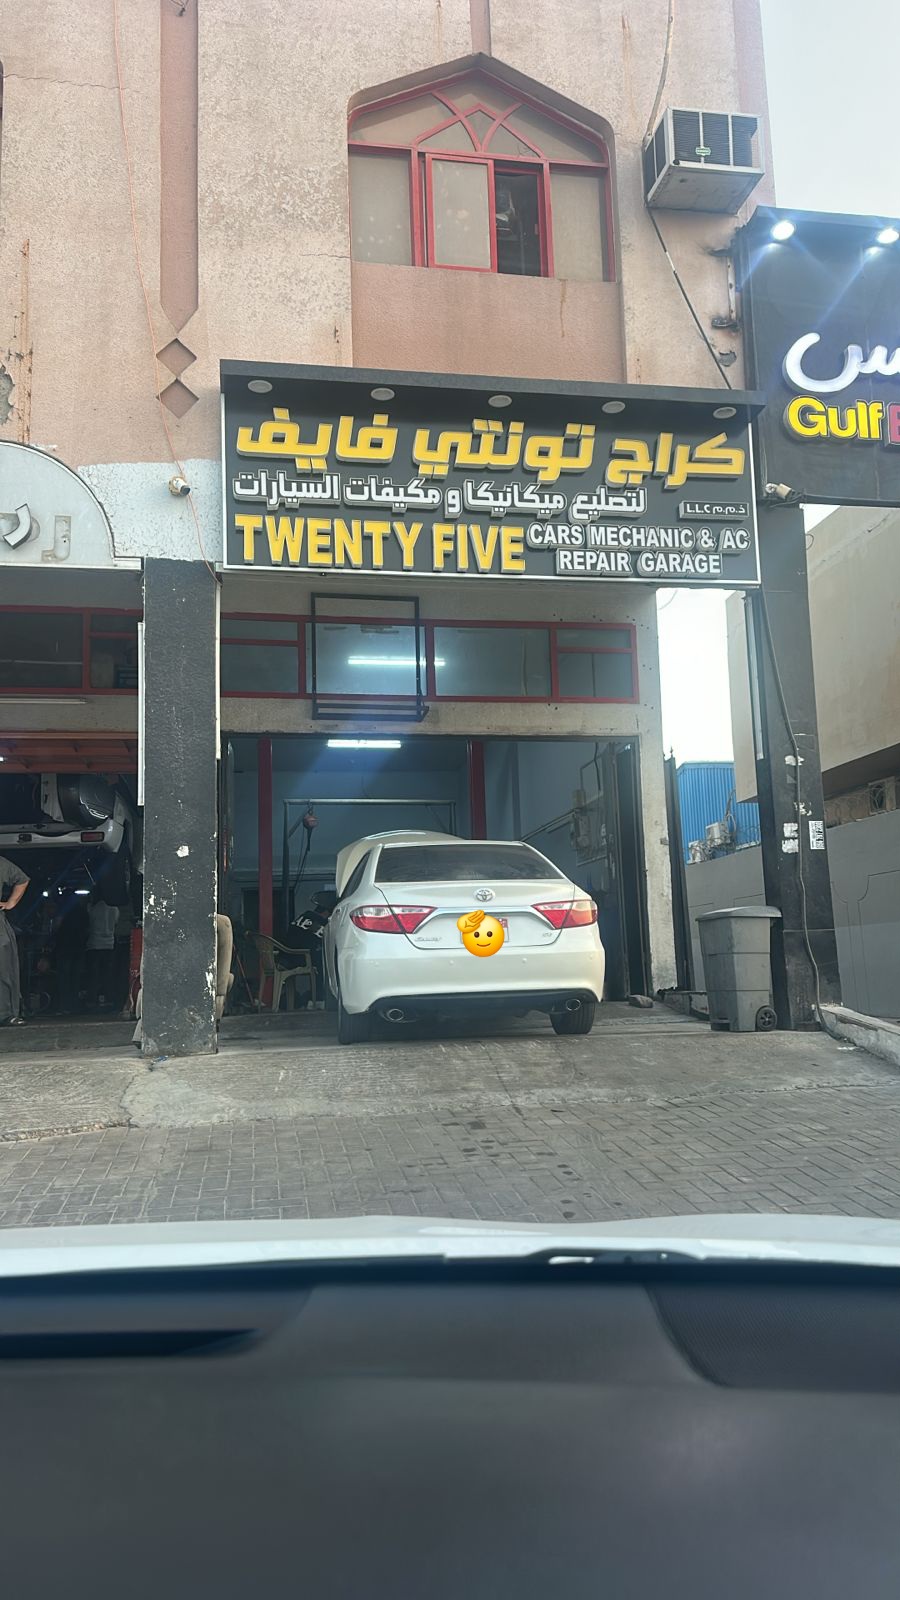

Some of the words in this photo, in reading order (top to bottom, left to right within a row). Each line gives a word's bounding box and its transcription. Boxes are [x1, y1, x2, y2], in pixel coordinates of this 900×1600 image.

[787, 396, 884, 440] Gulf
[236, 407, 399, 474] فايف
[412, 418, 597, 485] تونتي
[605, 432, 746, 488] كراج
[234, 471, 339, 505] السيارات
[344, 475, 441, 507] مكيفات
[448, 490, 461, 513] و
[465, 480, 566, 515] ميكانيكا
[235, 514, 423, 571] TWENTY
[432, 522, 526, 574] FIVE
[528, 523, 584, 546] CARS
[589, 525, 695, 549] MECHANIC
[699, 528, 716, 548] &
[722, 528, 749, 551] AC
[559, 550, 631, 572] REPAIR
[640, 553, 721, 574] GARAGE
